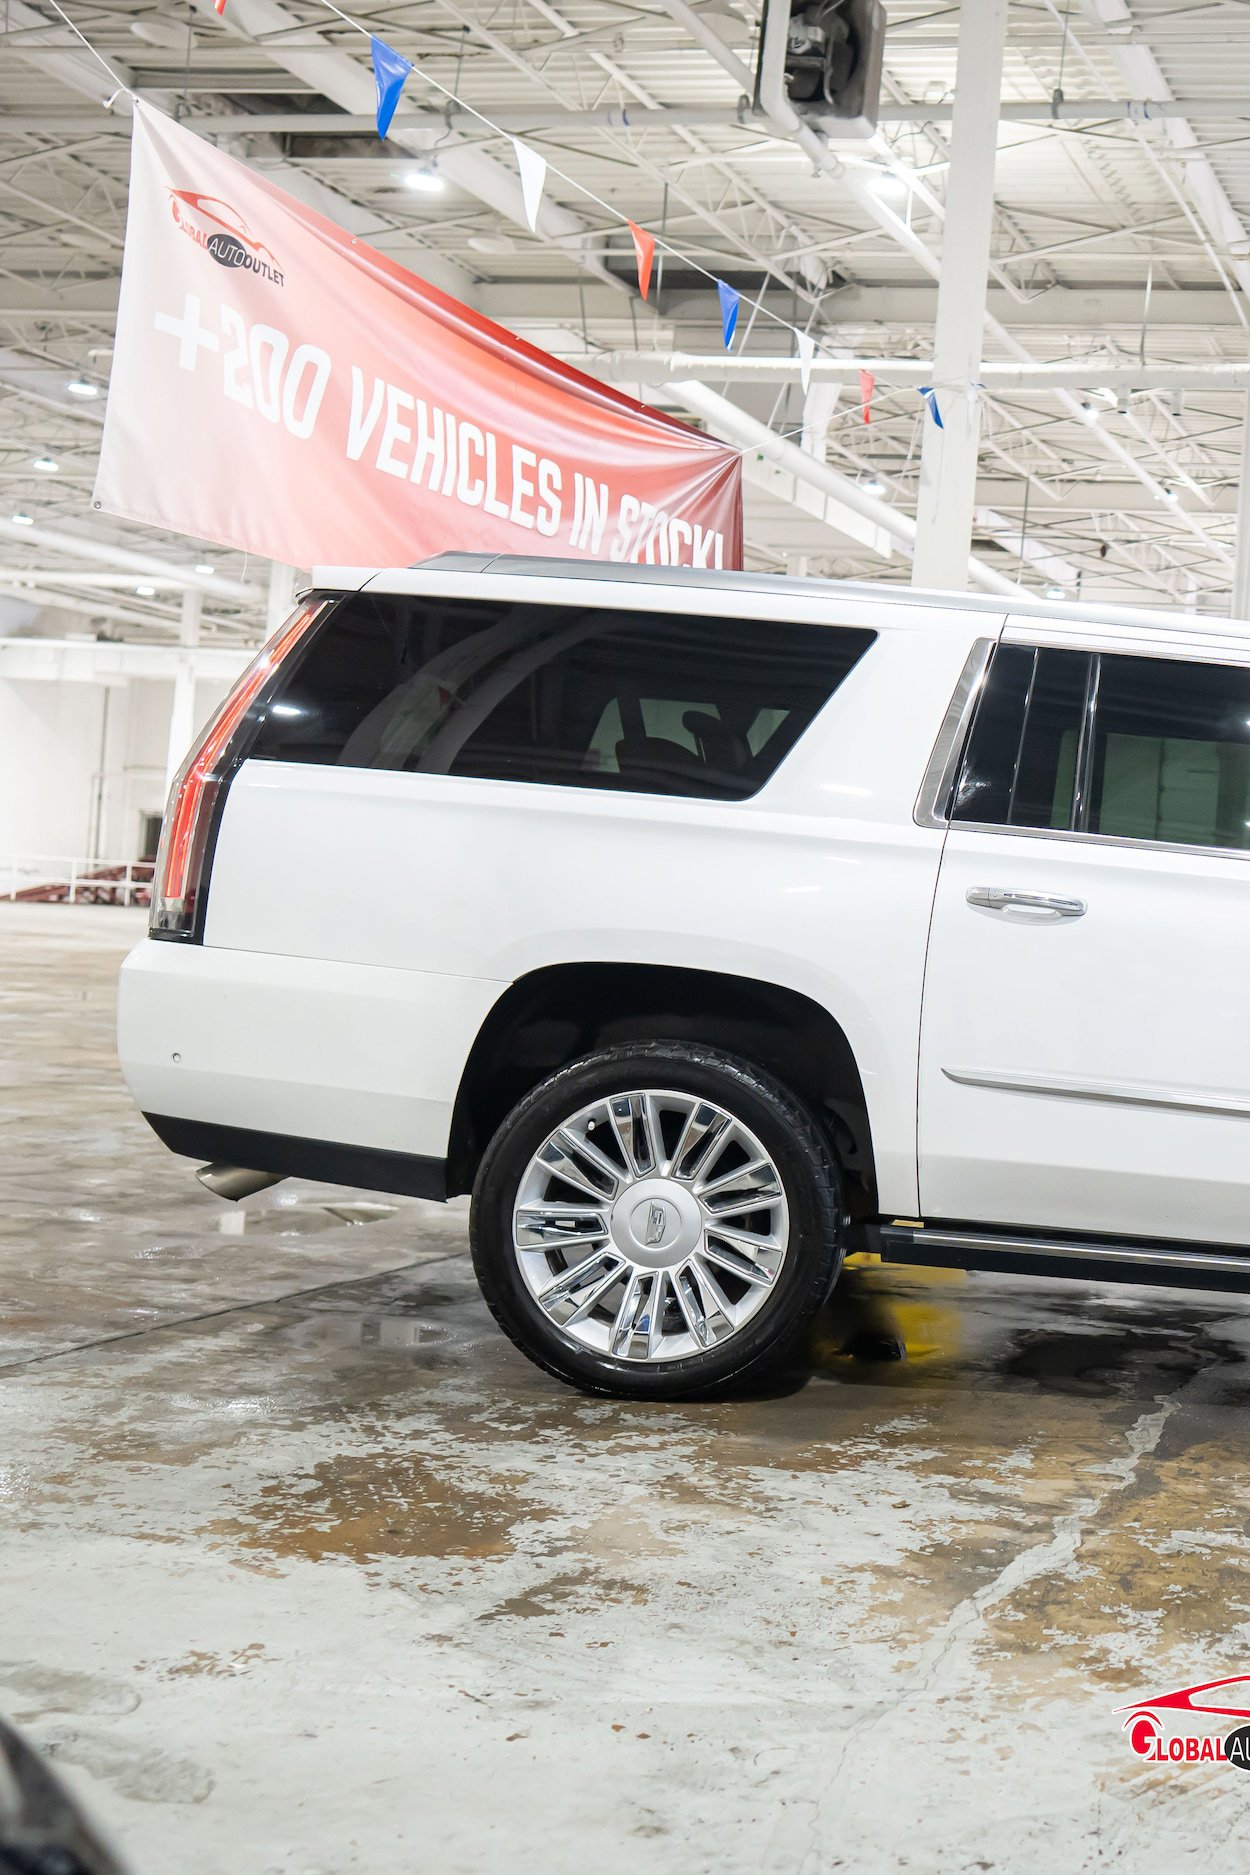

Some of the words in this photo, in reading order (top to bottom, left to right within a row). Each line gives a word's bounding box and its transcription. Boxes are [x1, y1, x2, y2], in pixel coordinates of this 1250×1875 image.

[154, 293, 332, 440] +200
[346, 365, 563, 537] VEHICLES
[568, 472, 609, 556] IN
